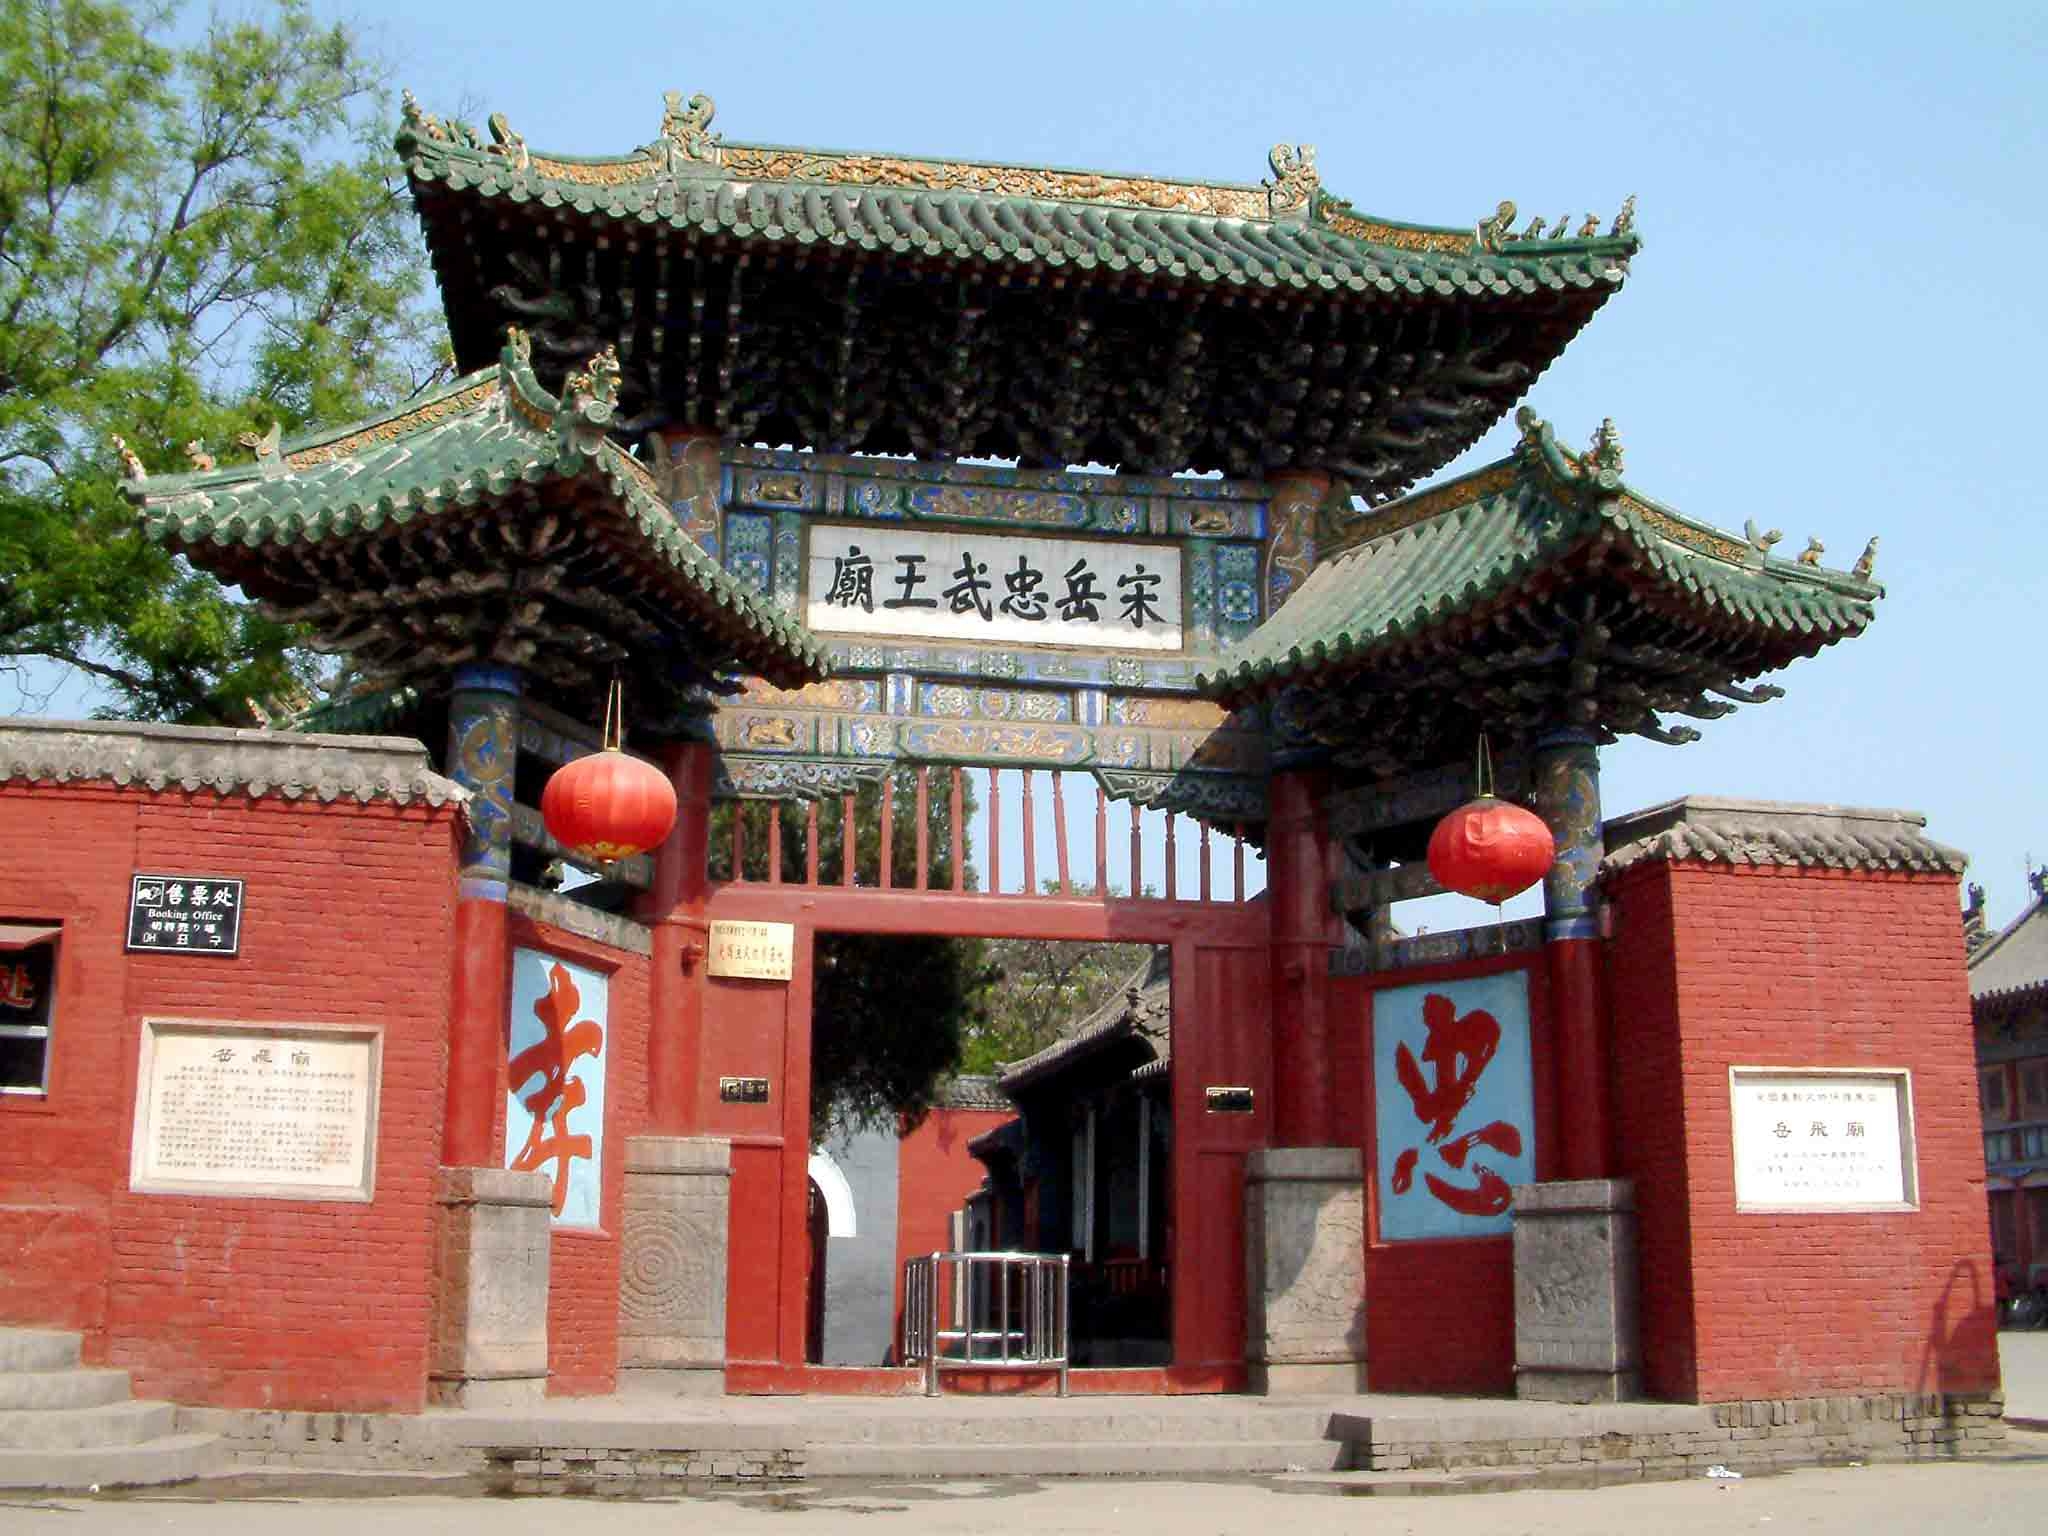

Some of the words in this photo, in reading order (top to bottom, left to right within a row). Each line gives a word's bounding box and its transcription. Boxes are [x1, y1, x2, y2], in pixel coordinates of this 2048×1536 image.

[165, 883, 235, 907] 售票处
[148, 908, 189, 921] Booking
[193, 911, 224, 922] Office
[1391, 992, 1523, 1217] 忠
[1772, 1121, 1866, 1139] 岳飛廟
